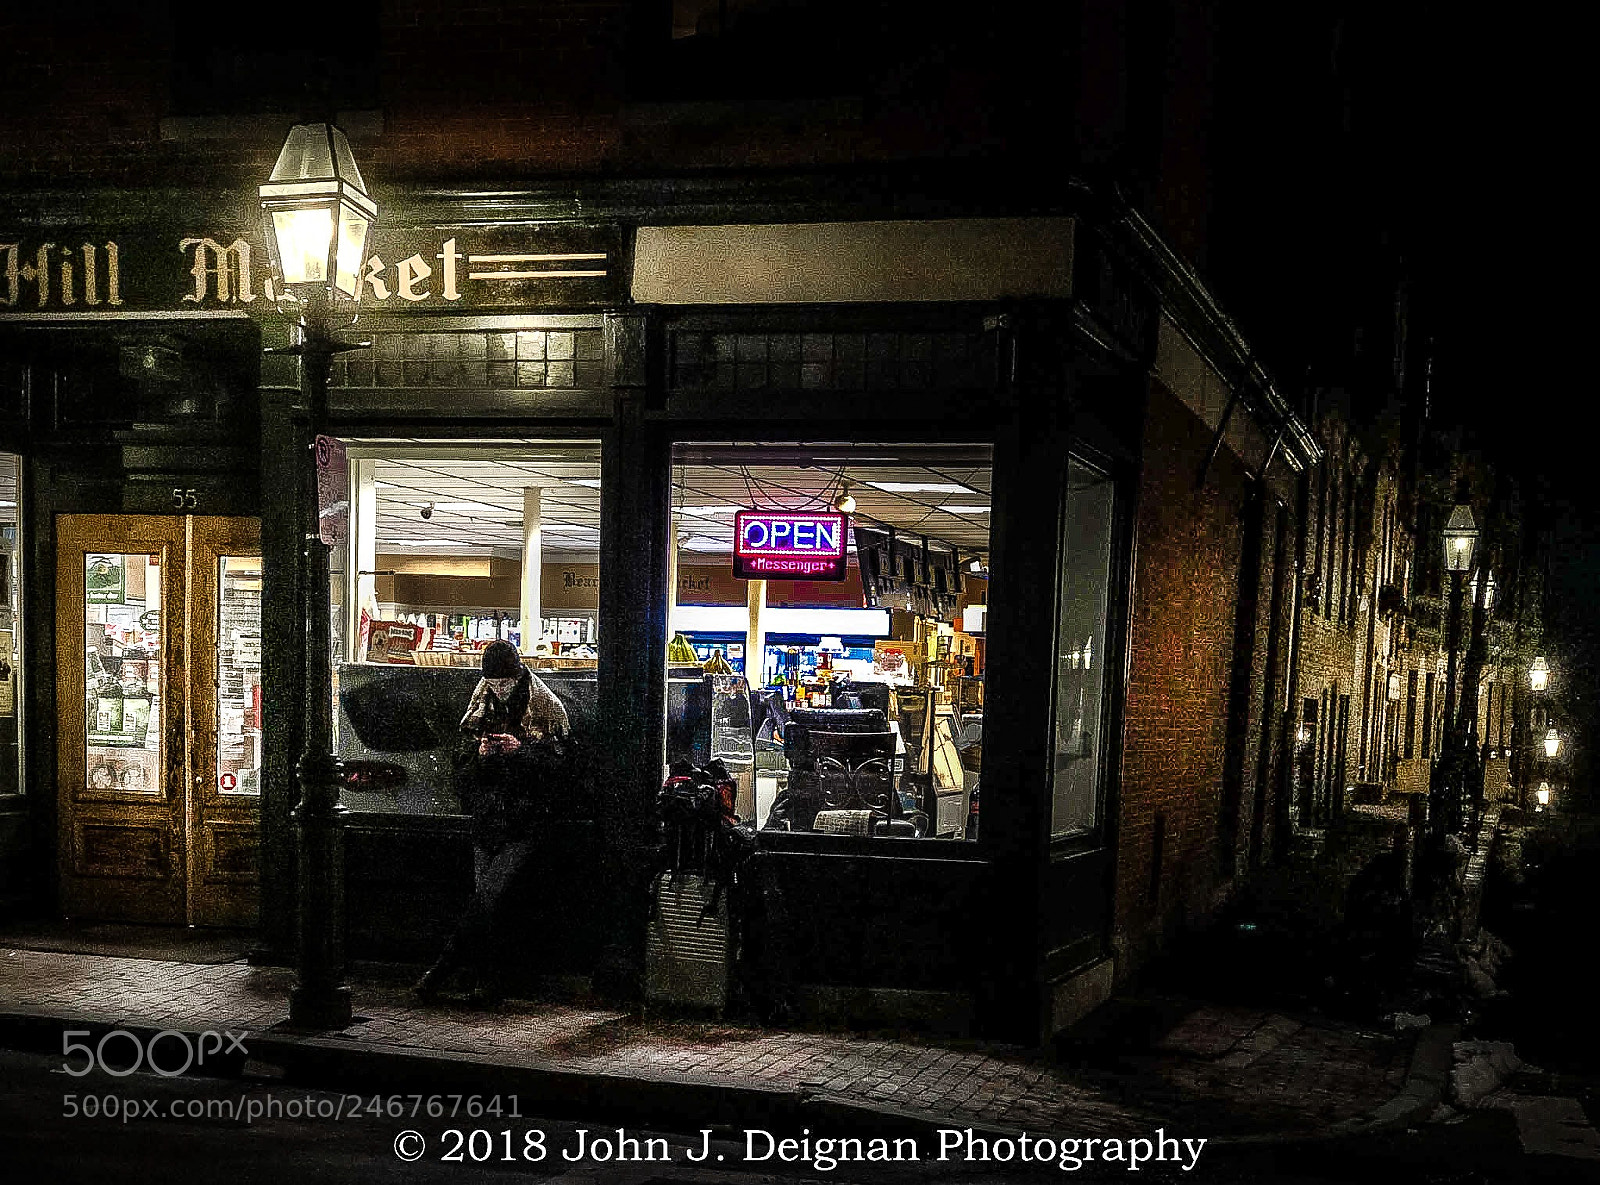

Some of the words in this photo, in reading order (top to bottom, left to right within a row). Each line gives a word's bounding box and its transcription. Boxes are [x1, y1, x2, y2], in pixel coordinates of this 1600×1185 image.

[0, 241, 123, 305] Hill
[172, 488, 197, 508] 55
[743, 520, 838, 549] OPEN
